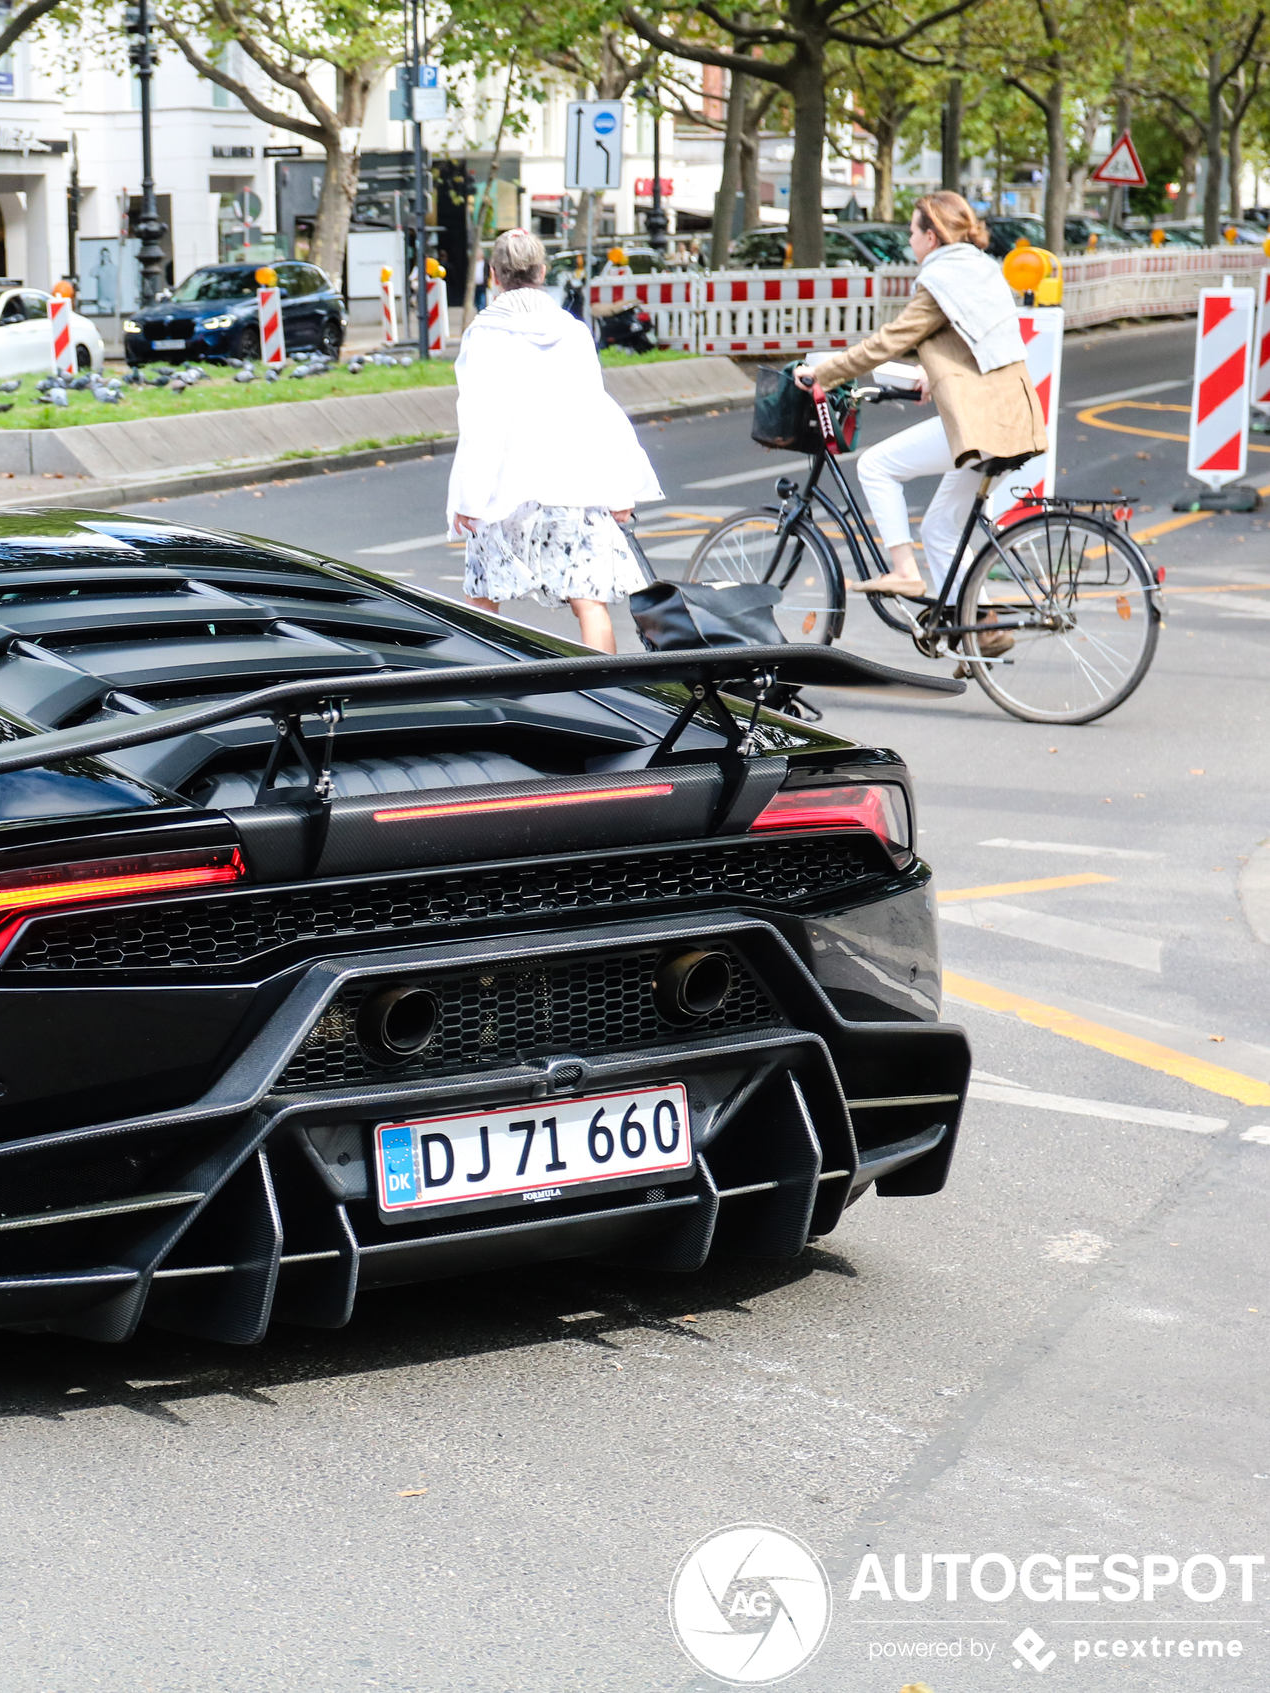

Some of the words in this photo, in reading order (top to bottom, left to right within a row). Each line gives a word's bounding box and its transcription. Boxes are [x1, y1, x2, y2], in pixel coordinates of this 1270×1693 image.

[423, 67, 436, 85] P
[420, 1126, 489, 1188] DJ
[509, 1116, 567, 1176] 71
[587, 1099, 680, 1164] 660
[388, 1172, 411, 1192] DK
[522, 1188, 562, 1201] FORMULA
